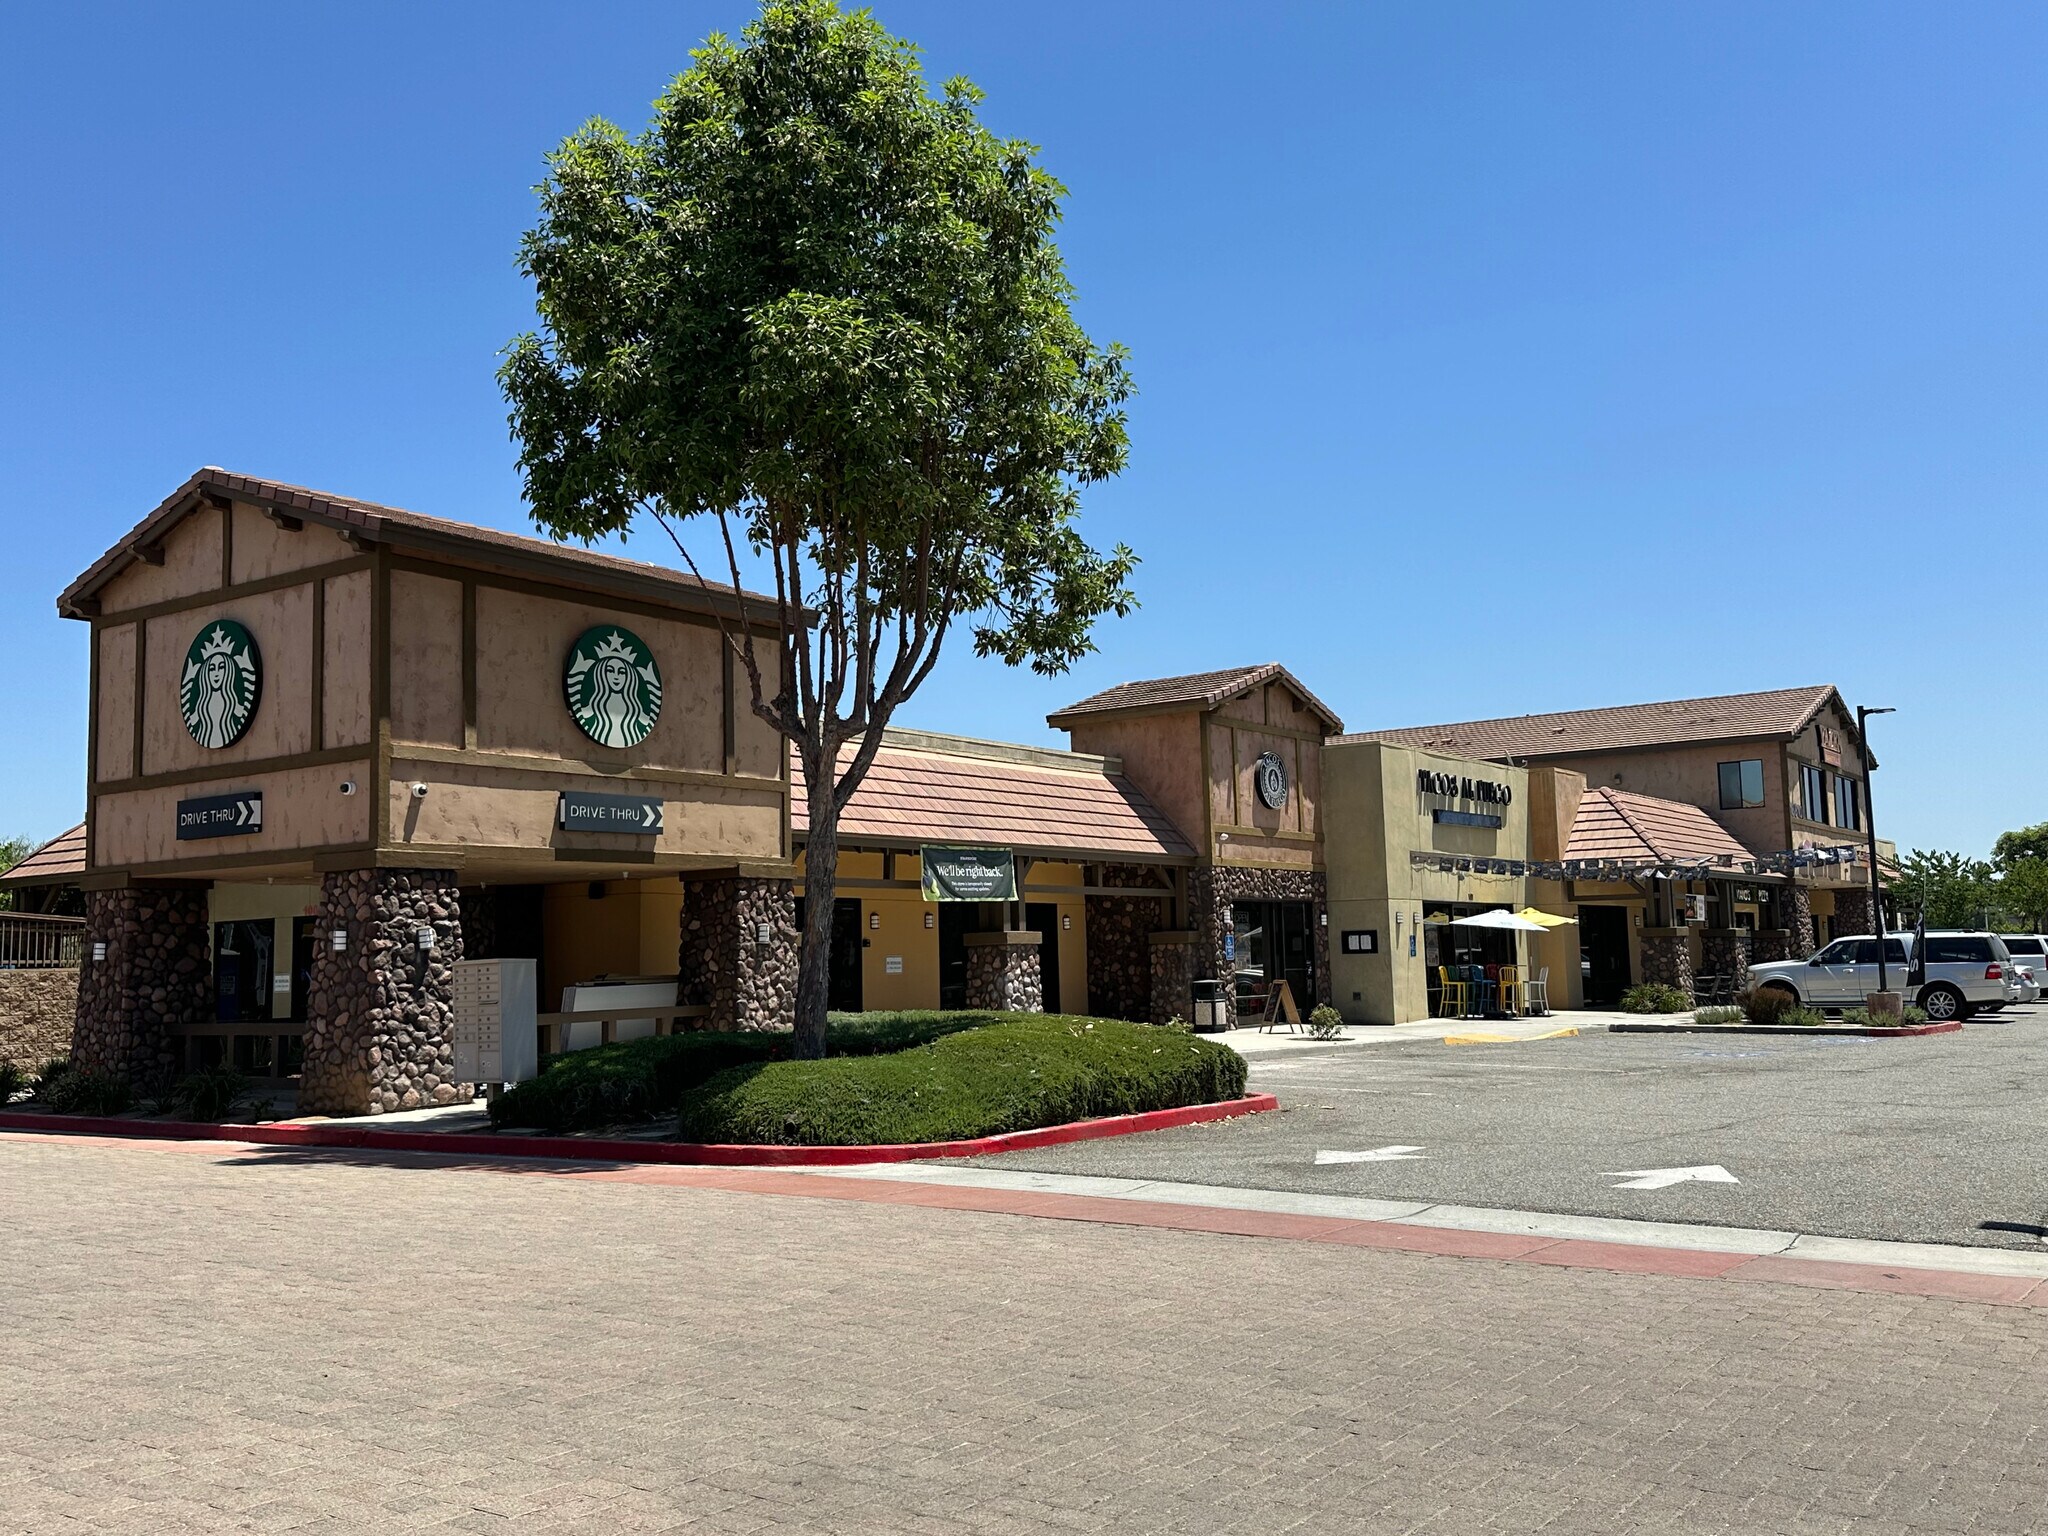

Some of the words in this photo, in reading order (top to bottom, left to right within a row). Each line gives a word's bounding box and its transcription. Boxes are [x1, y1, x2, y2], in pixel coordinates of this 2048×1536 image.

[1417, 769, 1459, 798] TACOS
[1461, 777, 1475, 801] AL
[1475, 780, 1512, 806] FUEGO
[181, 811, 208, 826] DRIVE
[210, 808, 235, 823] THRU
[570, 805, 606, 819] DRIVE
[610, 807, 640, 821] THRU
[936, 864, 955, 877] We'll
[955, 864, 966, 877] be
[965, 865, 984, 879] right
